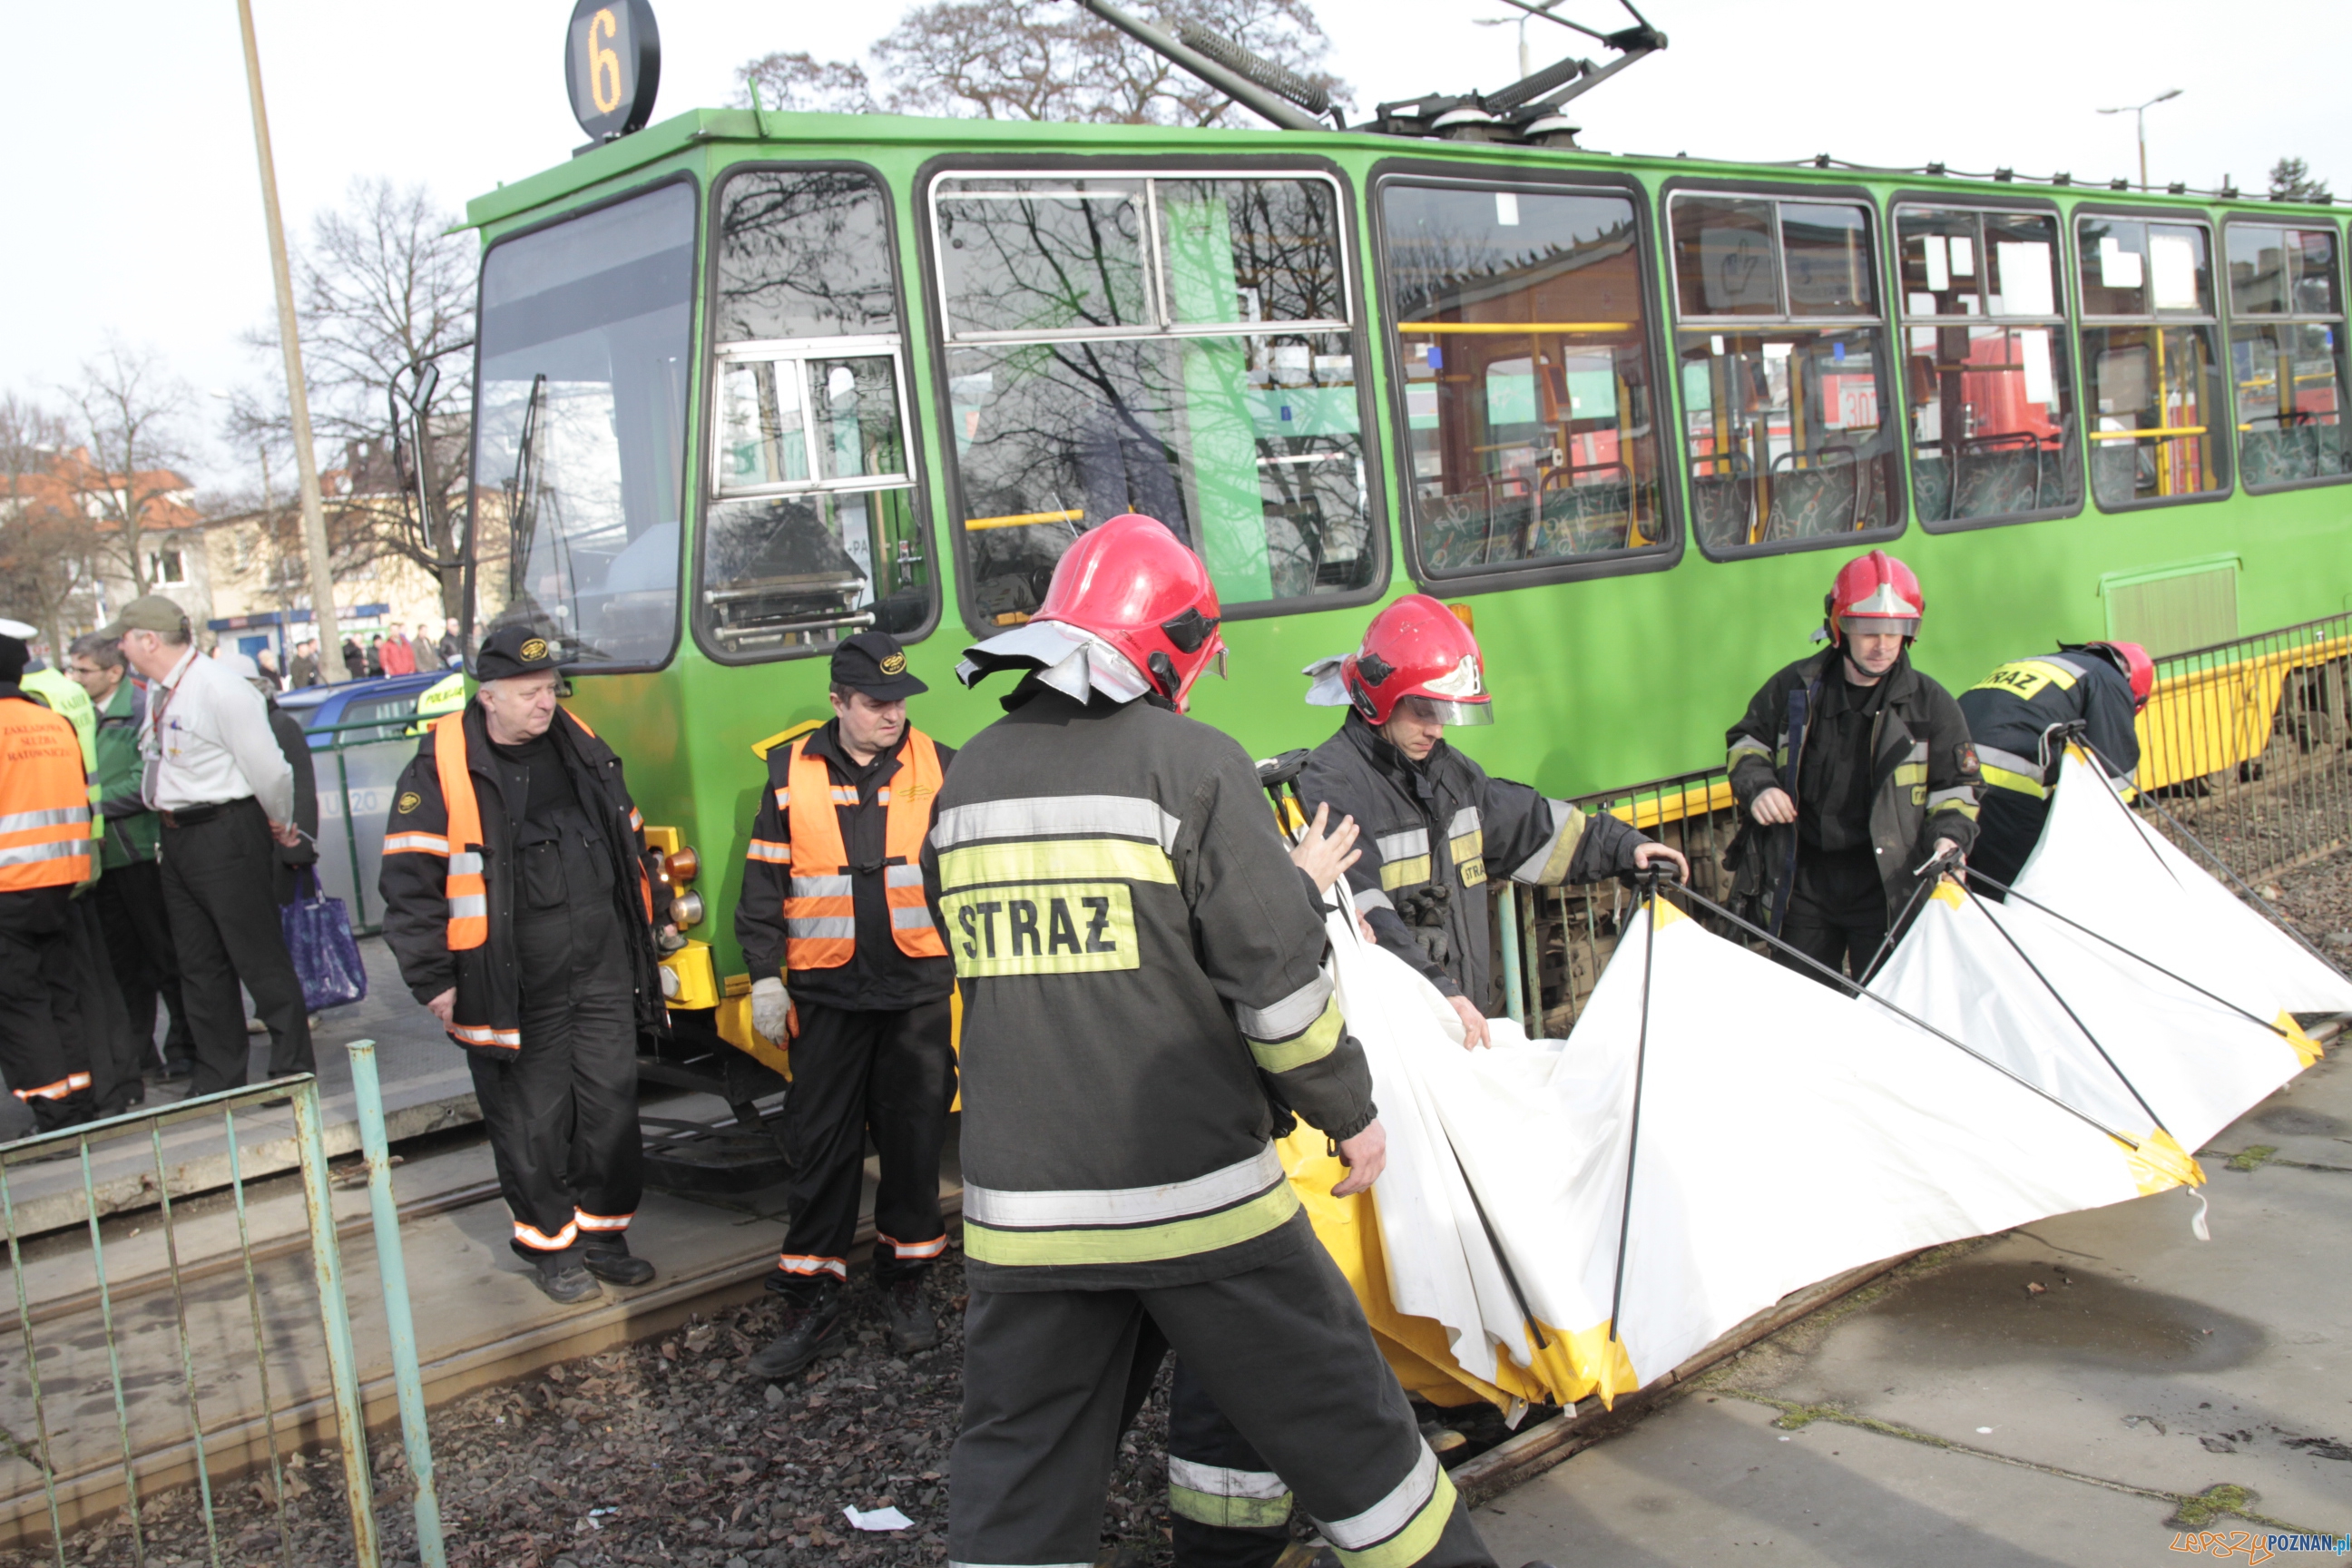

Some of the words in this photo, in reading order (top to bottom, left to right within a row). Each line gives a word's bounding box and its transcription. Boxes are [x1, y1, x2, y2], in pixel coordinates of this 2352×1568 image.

[588, 8, 621, 113] 6
[350, 790, 377, 812] 20
[1465, 863, 1485, 880] STRA
